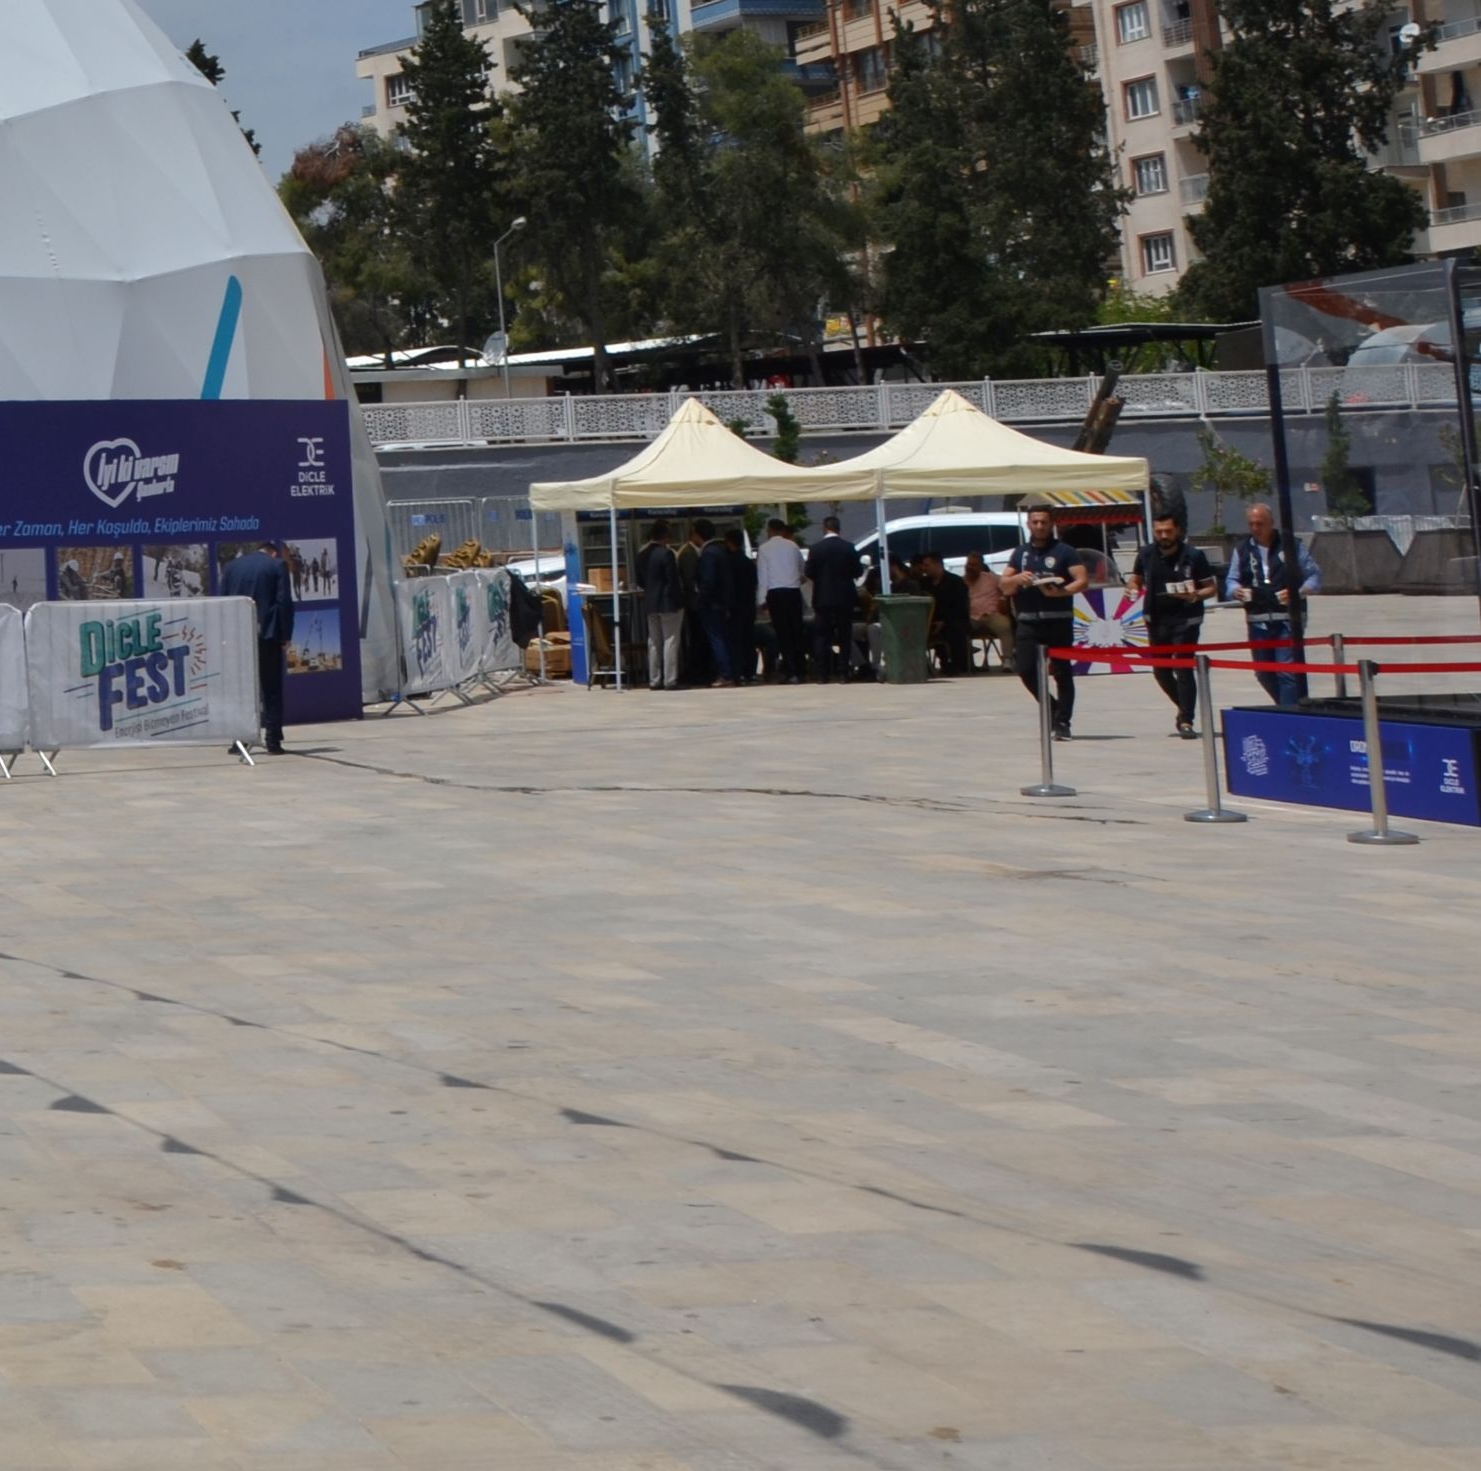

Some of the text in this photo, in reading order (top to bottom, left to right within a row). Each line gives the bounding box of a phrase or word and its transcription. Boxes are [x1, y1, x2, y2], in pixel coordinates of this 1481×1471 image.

[13, 519, 65, 538] Zaman,
[68, 518, 95, 536] Her
[154, 516, 218, 536] Ekiplerimiz
[219, 515, 260, 532] Sahada
[98, 645, 190, 732] FEST
